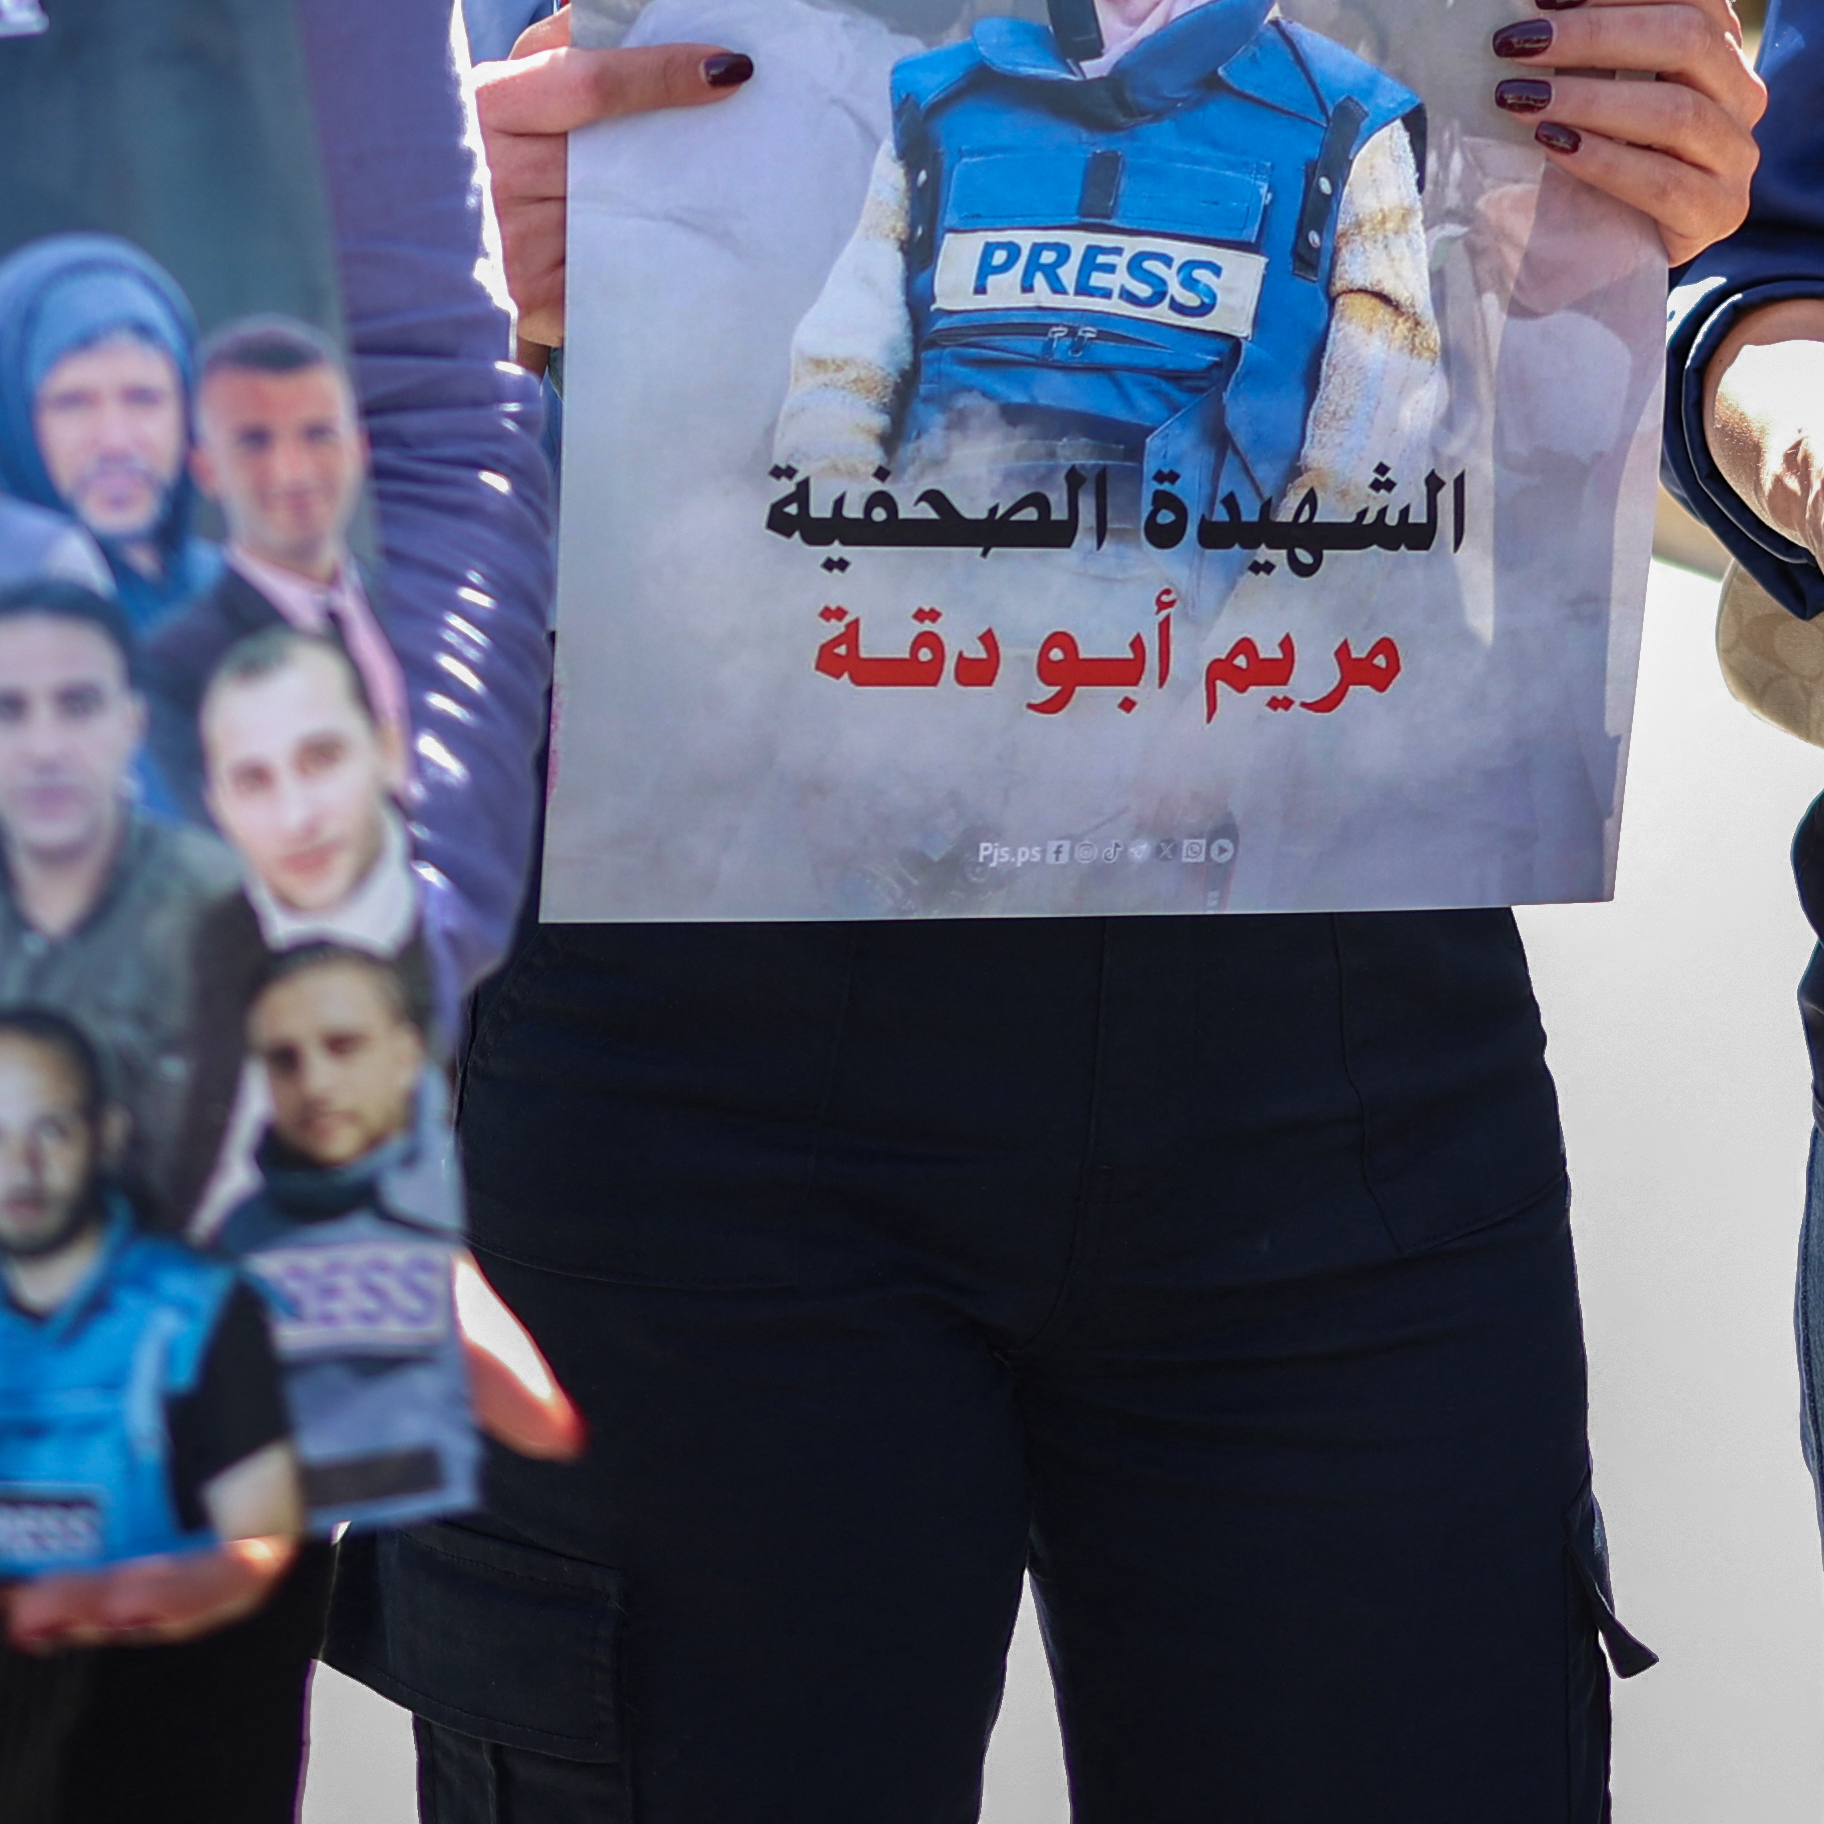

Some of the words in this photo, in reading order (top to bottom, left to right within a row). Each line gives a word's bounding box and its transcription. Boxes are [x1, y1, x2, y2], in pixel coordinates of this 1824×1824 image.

[972, 240, 1224, 319] PRESS
[763, 461, 1109, 574] الصحفية
[1142, 461, 1466, 578] الشهيدة
[813, 604, 1000, 688] دقة
[1025, 586, 1178, 715] أبو
[1204, 631, 1402, 725] مريم
[977, 841, 1042, 868] Pjs.ps
